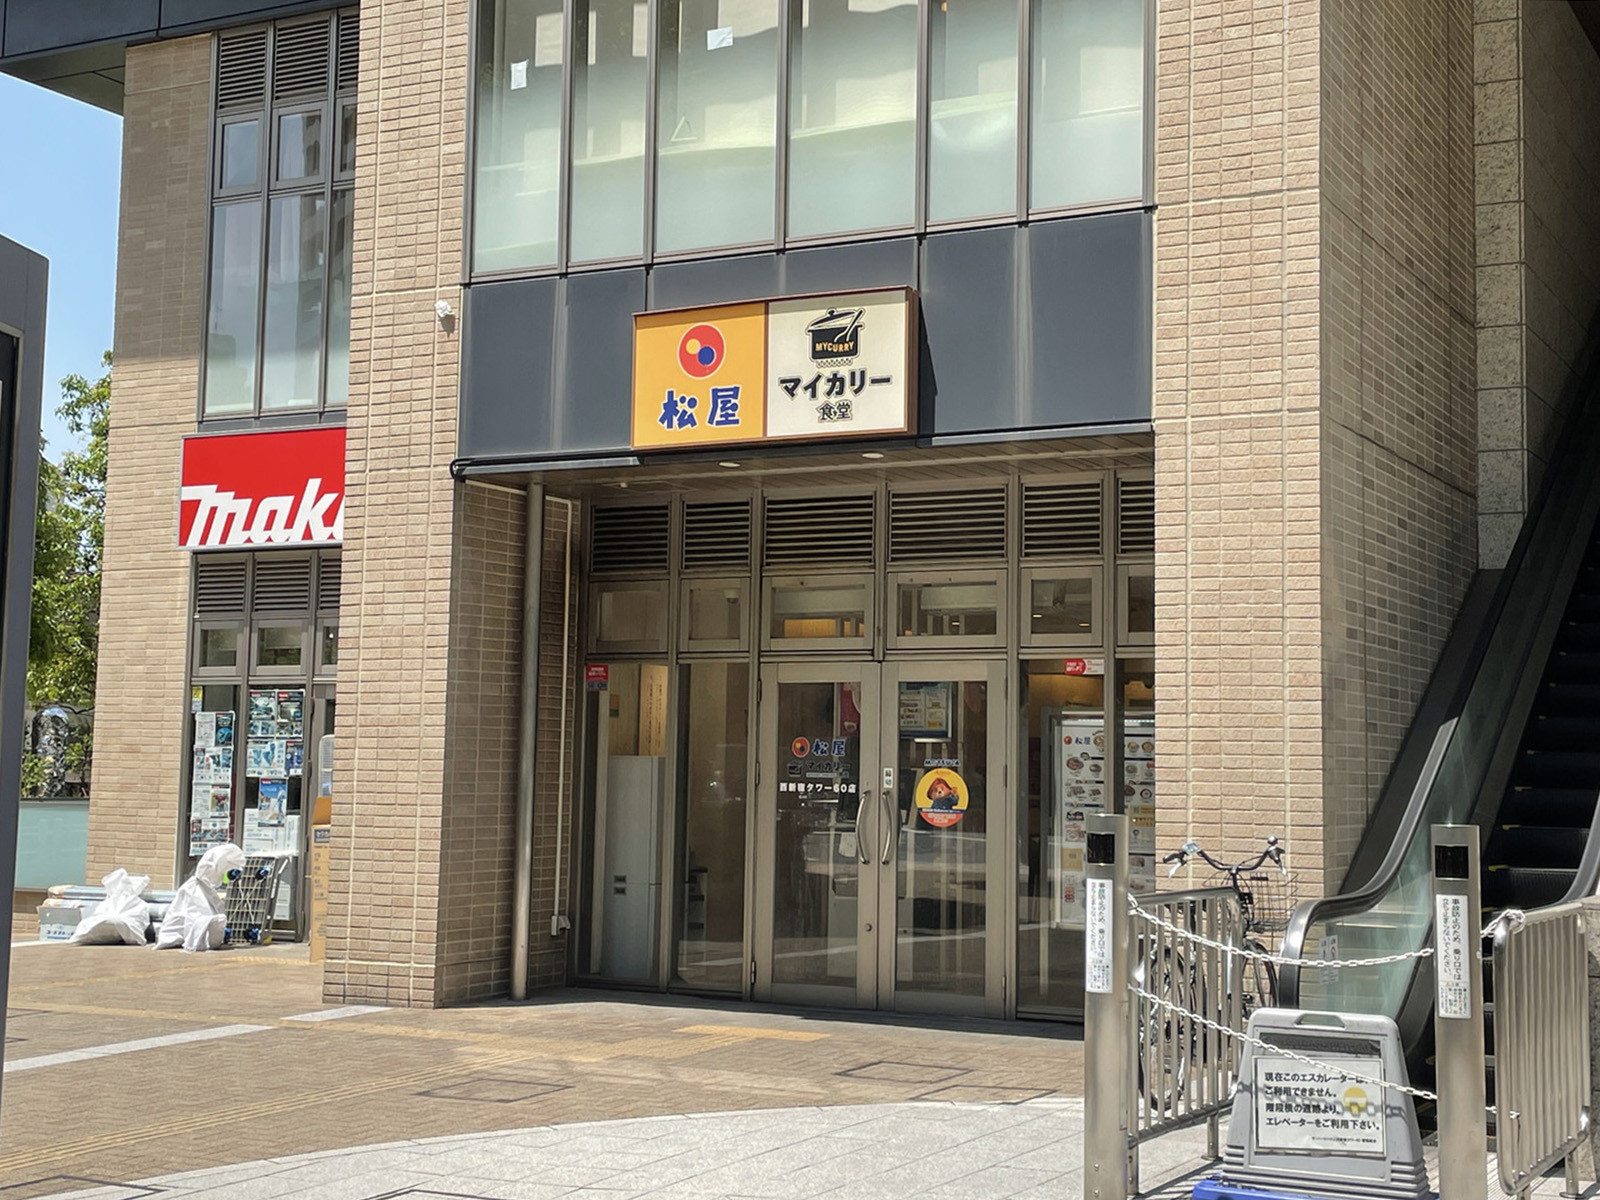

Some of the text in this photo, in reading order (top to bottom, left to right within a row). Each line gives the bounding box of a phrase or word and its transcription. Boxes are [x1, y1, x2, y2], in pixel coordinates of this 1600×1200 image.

[815, 340, 855, 353] MYCURRY
[779, 368, 892, 400] マイカリー
[659, 386, 741, 429] 松屋
[820, 402, 851, 421] 食堂
[813, 739, 846, 756] 松屋
[779, 782, 857, 795] 西新宿タワー60店
[1265, 1086, 1337, 1097] ご利用できません。
[1266, 1118, 1380, 1130] エレベーターをご利用下さい。
